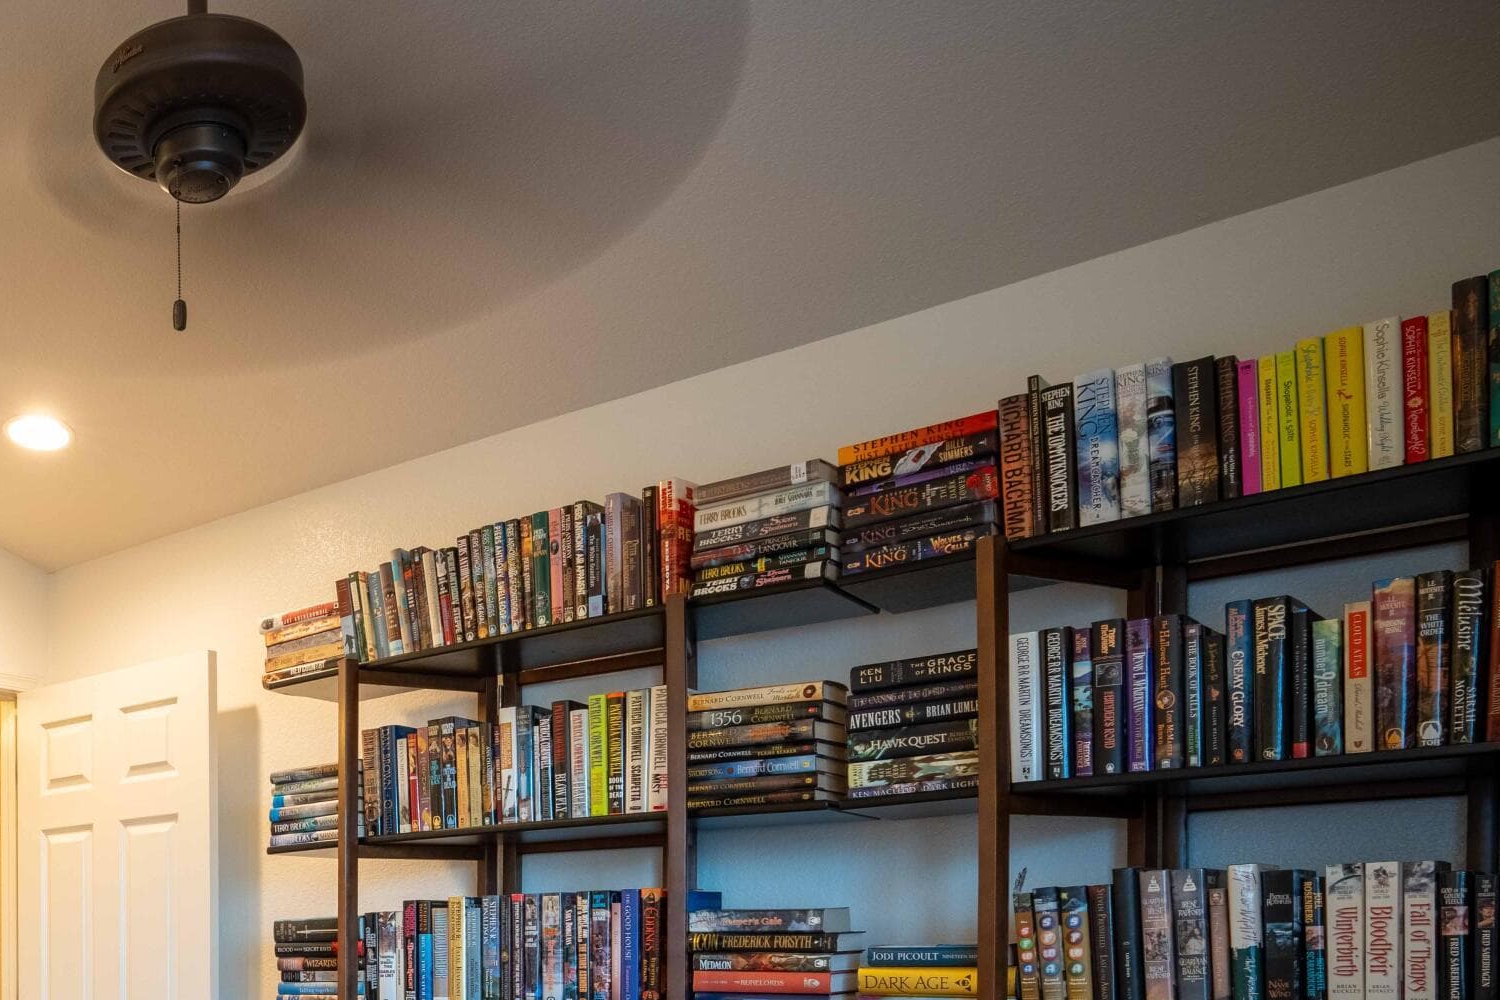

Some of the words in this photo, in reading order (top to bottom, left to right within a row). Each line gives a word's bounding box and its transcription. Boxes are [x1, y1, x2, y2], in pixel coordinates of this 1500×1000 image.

[1373, 323, 1388, 358] Sophie
[1405, 325, 1415, 355] SOPHIE
[1186, 366, 1198, 404] STEPHEN
[1219, 360, 1231, 411] STEPHEN
[1406, 356, 1417, 398] KINSELLA
[1048, 413, 1063, 434] THE
[1189, 406, 1201, 432] KING
[1222, 414, 1235, 442] KING
[853, 430, 918, 453] STEPHEN
[927, 419, 965, 435] KING
[939, 445, 974, 463] SUMMERS
[845, 463, 892, 484] KING
[1048, 435, 1069, 512] TOMMYKNOCKERS
[700, 510, 720, 526] TERRY
[720, 505, 747, 520] BROOKS
[1255, 606, 1266, 630] James
[1267, 604, 1286, 641] SPACE
[1352, 614, 1363, 645] CLOUD
[927, 653, 977, 668] GRACE
[1017, 638, 1029, 665] GEORGE
[1046, 632, 1059, 661] GEORGE
[1256, 639, 1268, 674] Michener
[860, 667, 882, 677] KEN
[927, 662, 972, 676] KINGS
[1231, 651, 1245, 688] ENEMY
[1353, 649, 1364, 677] ATLAS
[860, 676, 883, 685] LIU
[1019, 677, 1031, 706] MARTIN
[1048, 675, 1060, 705] MARTIN
[1160, 667, 1171, 689] Hunt
[590, 698, 602, 729] PATRICIA
[610, 704, 621, 735] PATRICIA
[631, 696, 642, 725] PATRICIA
[654, 688, 667, 725] PATRICIA
[709, 710, 742, 727] 1356
[850, 709, 901, 730] AVENGERS
[926, 703, 951, 718] BRIAN
[1232, 691, 1245, 728] GLORY
[1453, 680, 1466, 733] MONETTE
[631, 727, 642, 762] CORNWELL
[1019, 709, 1032, 758] DREAMSONGS
[1049, 709, 1062, 760] DREAMSONGS
[591, 731, 602, 768] CORNWELL
[610, 738, 621, 775] CORNWELL
[654, 727, 667, 770] CORNWELL
[690, 752, 717, 761] BERNARD
[718, 750, 752, 759] CORNWELL
[737, 763, 766, 775] Bernard
[767, 760, 800, 773] Cornwell
[631, 765, 642, 801] SCARPETTA
[651, 774, 661, 794] MIST
[923, 782, 948, 792] DARK
[724, 796, 766, 806] CORNWELL
[1304, 881, 1313, 924] ROSENBERG
[1410, 903, 1431, 920] Fall
[693, 934, 718, 950] ICON
[722, 936, 770, 949] FREDERICK
[773, 936, 812, 949] FORSYTH
[1333, 906, 1359, 977] Winterbirth
[1367, 906, 1394, 977] Bloodheir
[1410, 930, 1431, 945] of
[1450, 938, 1460, 955] FRED
[700, 960, 732, 970] MEDALON
[1407, 946, 1431, 993] Thanes
[865, 976, 909, 993] DARK
[914, 976, 949, 990] AGE
